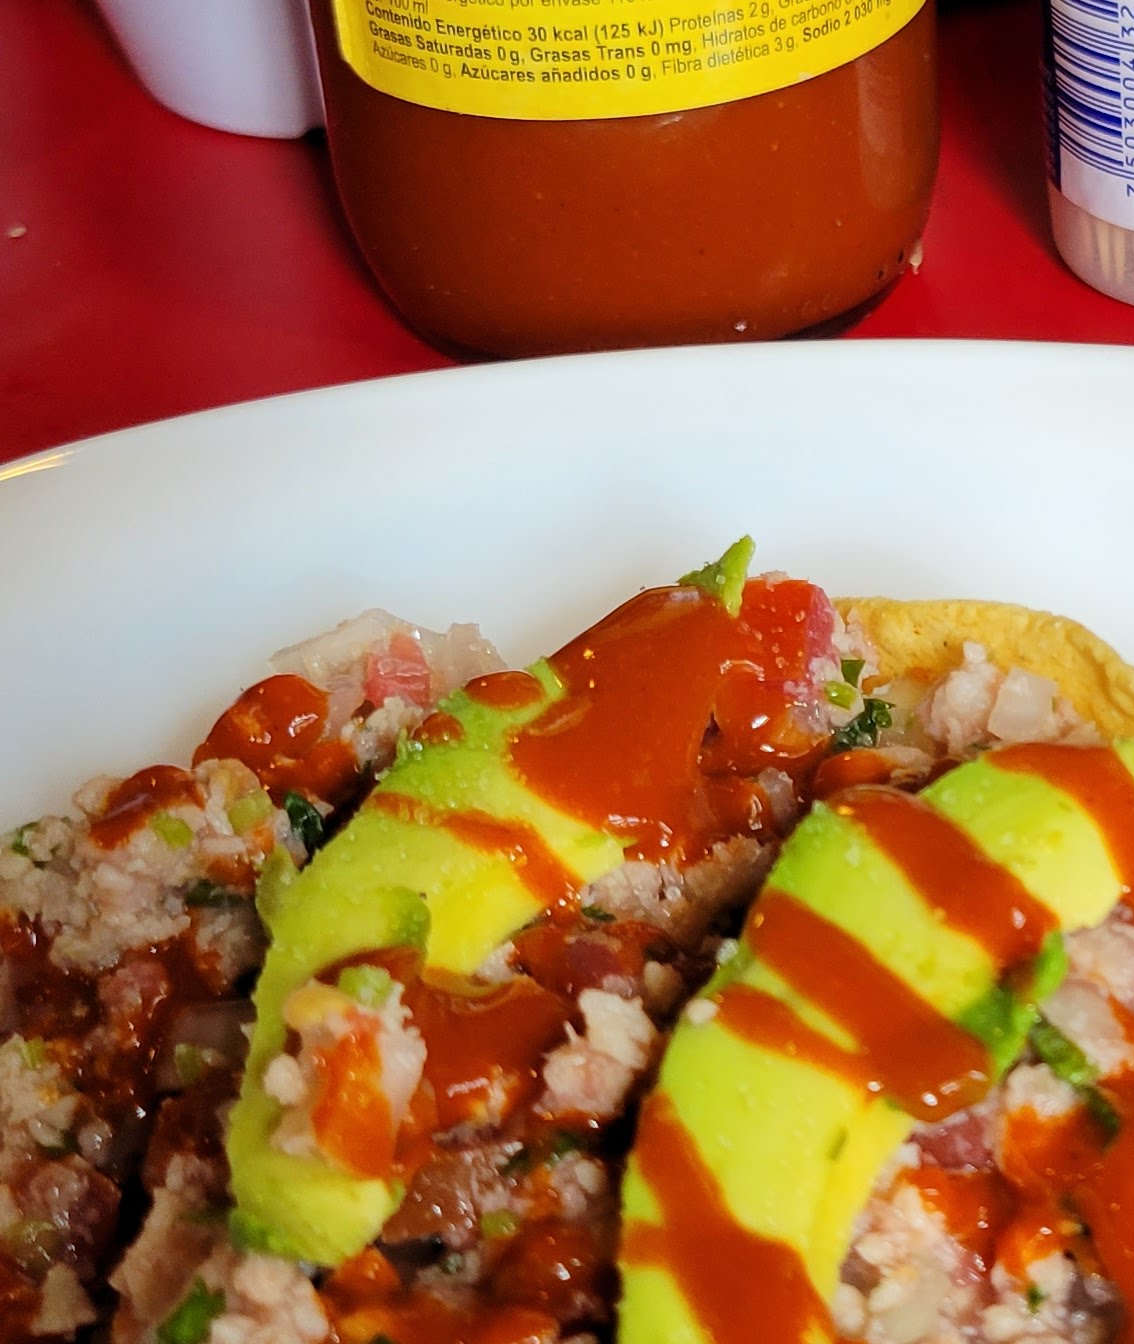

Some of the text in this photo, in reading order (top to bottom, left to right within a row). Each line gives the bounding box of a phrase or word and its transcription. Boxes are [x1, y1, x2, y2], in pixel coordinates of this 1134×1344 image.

[365, 0, 432, 33] Contenido
[435, 18, 522, 43] Energético
[527, 26, 547, 42] 30
[553, 25, 588, 42] kcal
[594, 23, 630, 44] (125
[638, 19, 664, 37] kJ)
[669, 8, 744, 33] Proteínas
[412, 0, 429, 15] ml
[369, 20, 412, 47] Grasas
[416, 34, 492, 60] Saturadas
[530, 47, 591, 63] Grasas
[596, 44, 645, 60] Trans
[651, 41, 660, 56] 0
[702, 22, 766, 48] Hidratos
[769, 16, 787, 33] de
[372, 40, 427, 70] Azúcares
[461, 62, 535, 83] Azúcares
[541, 66, 620, 83] añadidos
[662, 57, 702, 76] Fibra
[707, 40, 770, 68] dietética
[802, 17, 841, 44] Sodio
